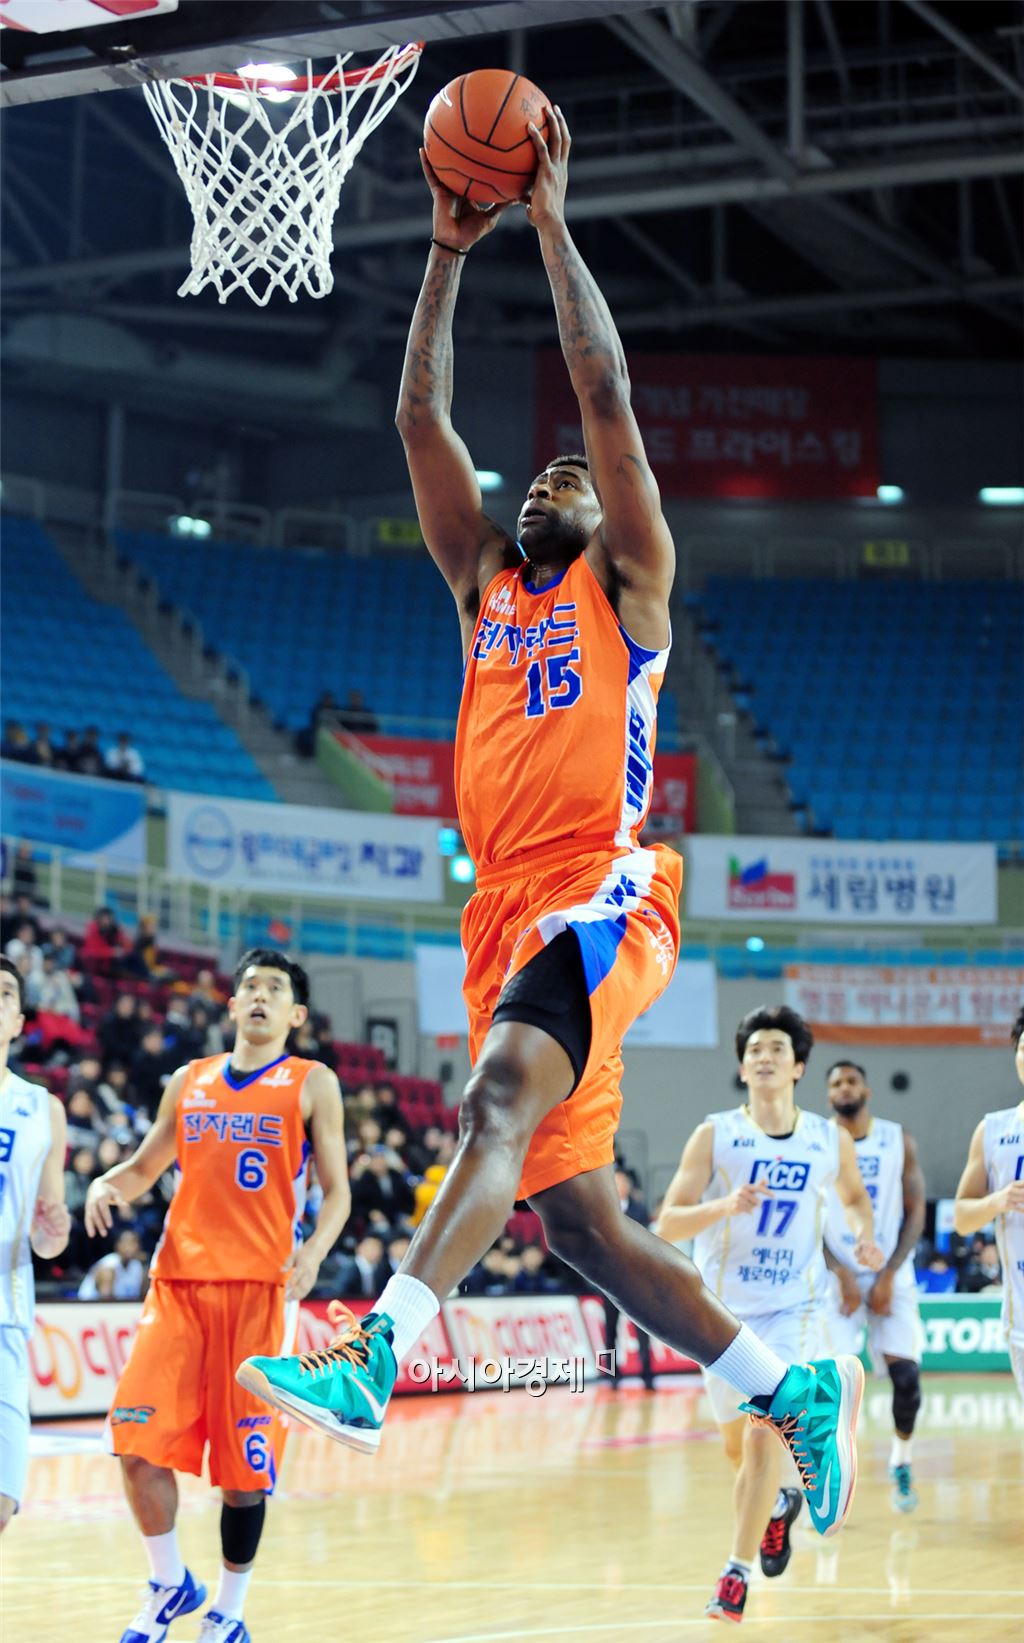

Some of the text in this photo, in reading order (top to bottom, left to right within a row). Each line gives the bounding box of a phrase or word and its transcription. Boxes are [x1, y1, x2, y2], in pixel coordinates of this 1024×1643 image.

[525, 647, 583, 719] 15
[808, 872, 956, 916] 세림병원
[183, 1111, 284, 1147] 전자랜드
[236, 1148, 268, 1192] 6
[752, 1156, 807, 1191] KCC
[756, 1198, 800, 1238] 17
[242, 1432, 268, 1473] 6
